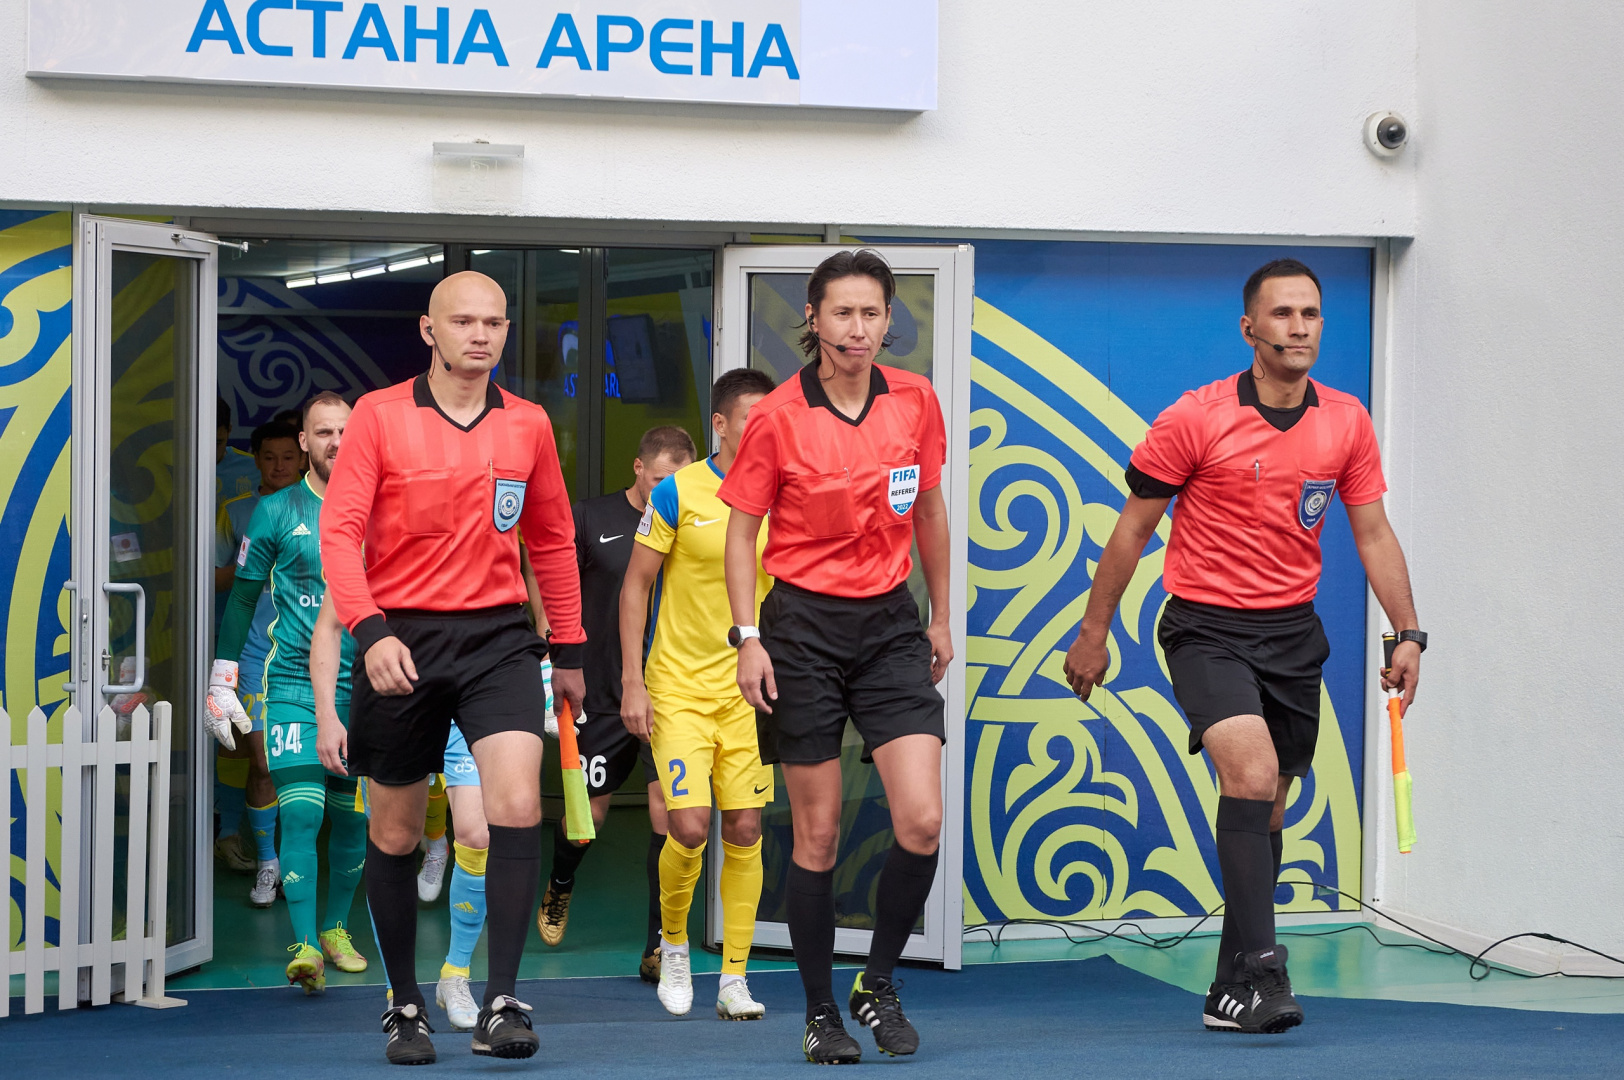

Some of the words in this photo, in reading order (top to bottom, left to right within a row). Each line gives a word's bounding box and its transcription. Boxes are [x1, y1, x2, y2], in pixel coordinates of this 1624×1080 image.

[185, 0, 509, 67] АСТАНА
[536, 13, 800, 80] АРЕНА
[891, 487, 916, 497] REFEREE
[892, 468, 917, 483] FIFA
[271, 723, 302, 757] 34
[668, 758, 689, 797] 2
